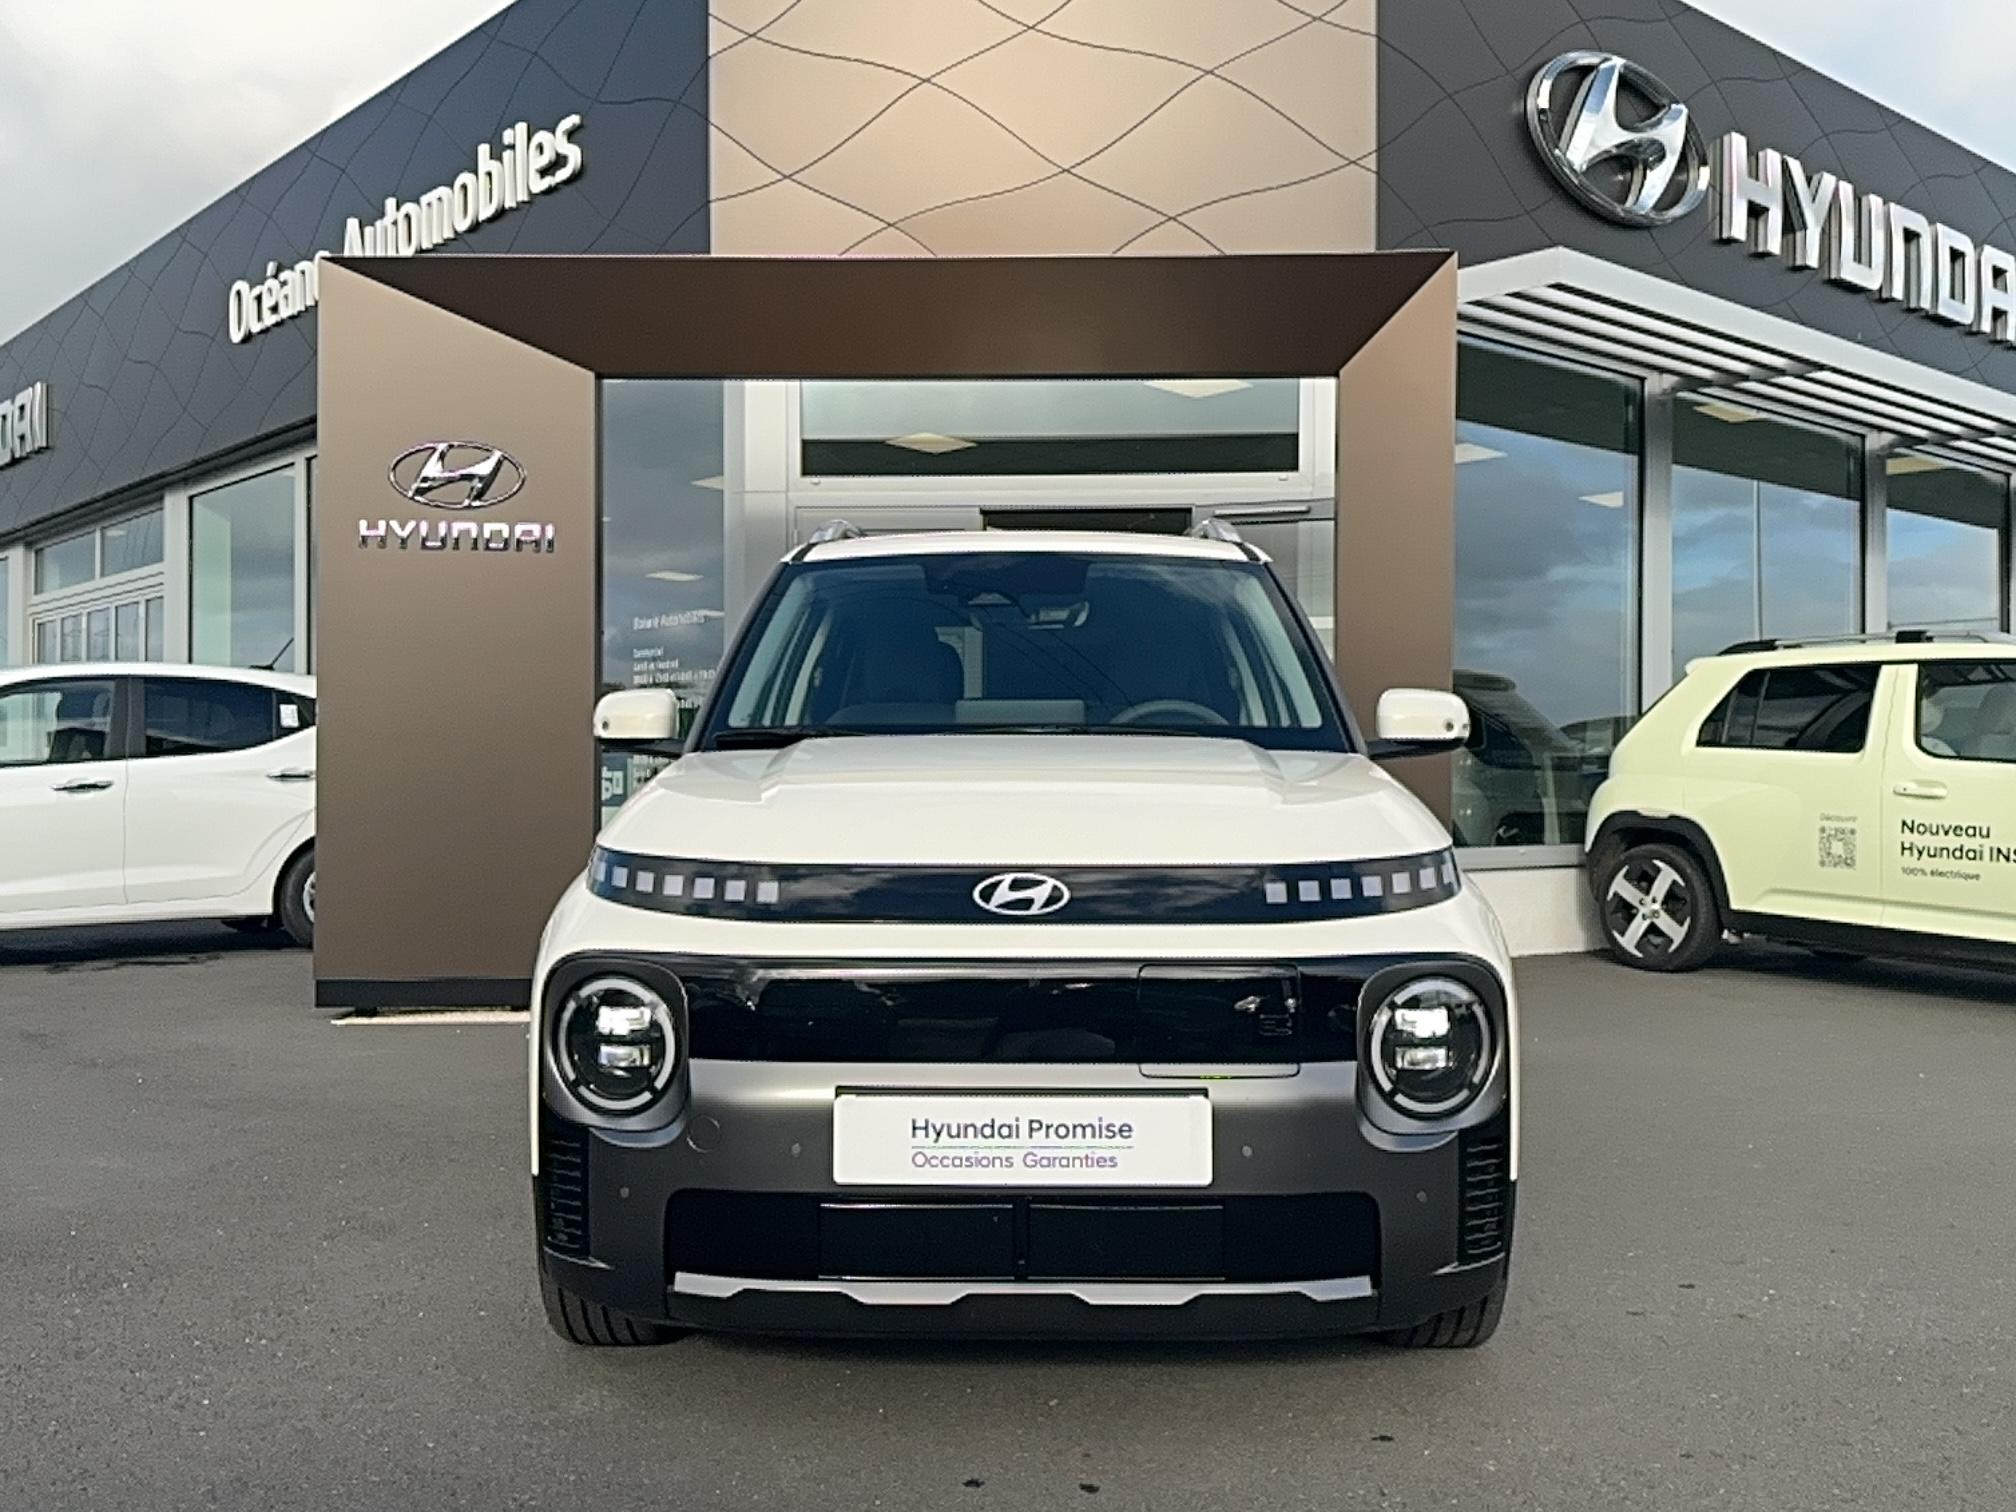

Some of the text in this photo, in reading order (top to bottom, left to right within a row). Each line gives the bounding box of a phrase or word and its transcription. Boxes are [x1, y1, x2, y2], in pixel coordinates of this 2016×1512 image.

[229, 114, 582, 343] Océan Automobiles
[358, 519, 554, 552] HYUNDAI
[1900, 818, 1990, 839] Nouveau
[1900, 841, 1984, 862] Hyundai
[1901, 866, 1928, 877] 100%
[911, 1117, 1133, 1143] Hyundai Promise
[911, 1151, 1118, 1169] Occasions Garanties
